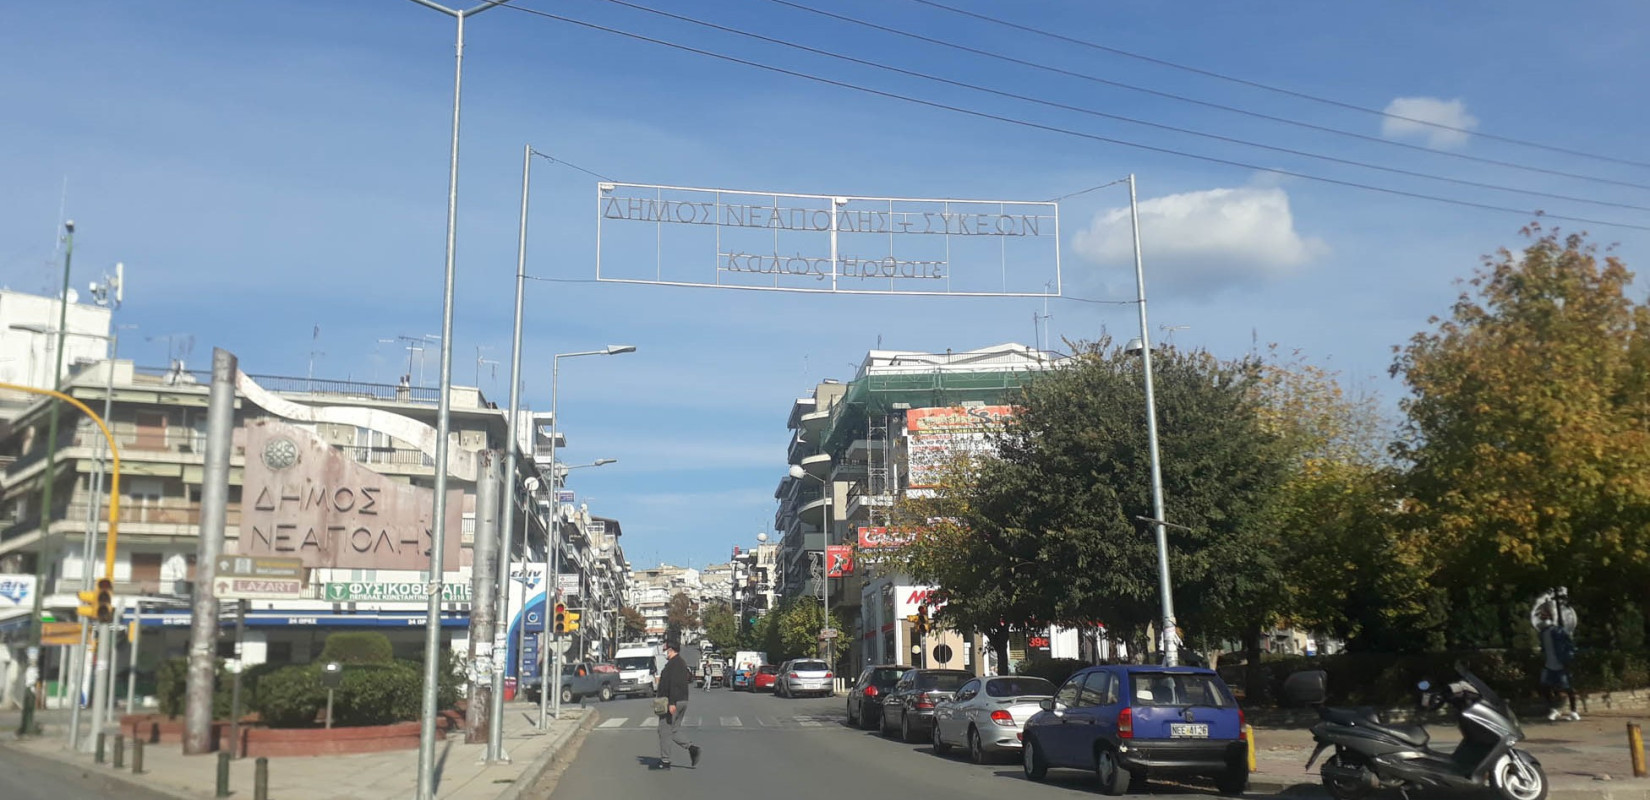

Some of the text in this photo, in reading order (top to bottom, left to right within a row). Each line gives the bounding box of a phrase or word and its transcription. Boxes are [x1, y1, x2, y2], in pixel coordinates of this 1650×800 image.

[604, 197, 713, 225] ΔΗΜΟΣ
[727, 204, 892, 233] ΝΕΑΠΟΛΗΣ
[923, 213, 1039, 236] ΣΥΚΕΩΝ
[254, 486, 380, 515] ΔΗΜΟΣ
[237, 581, 295, 592] LAZART
